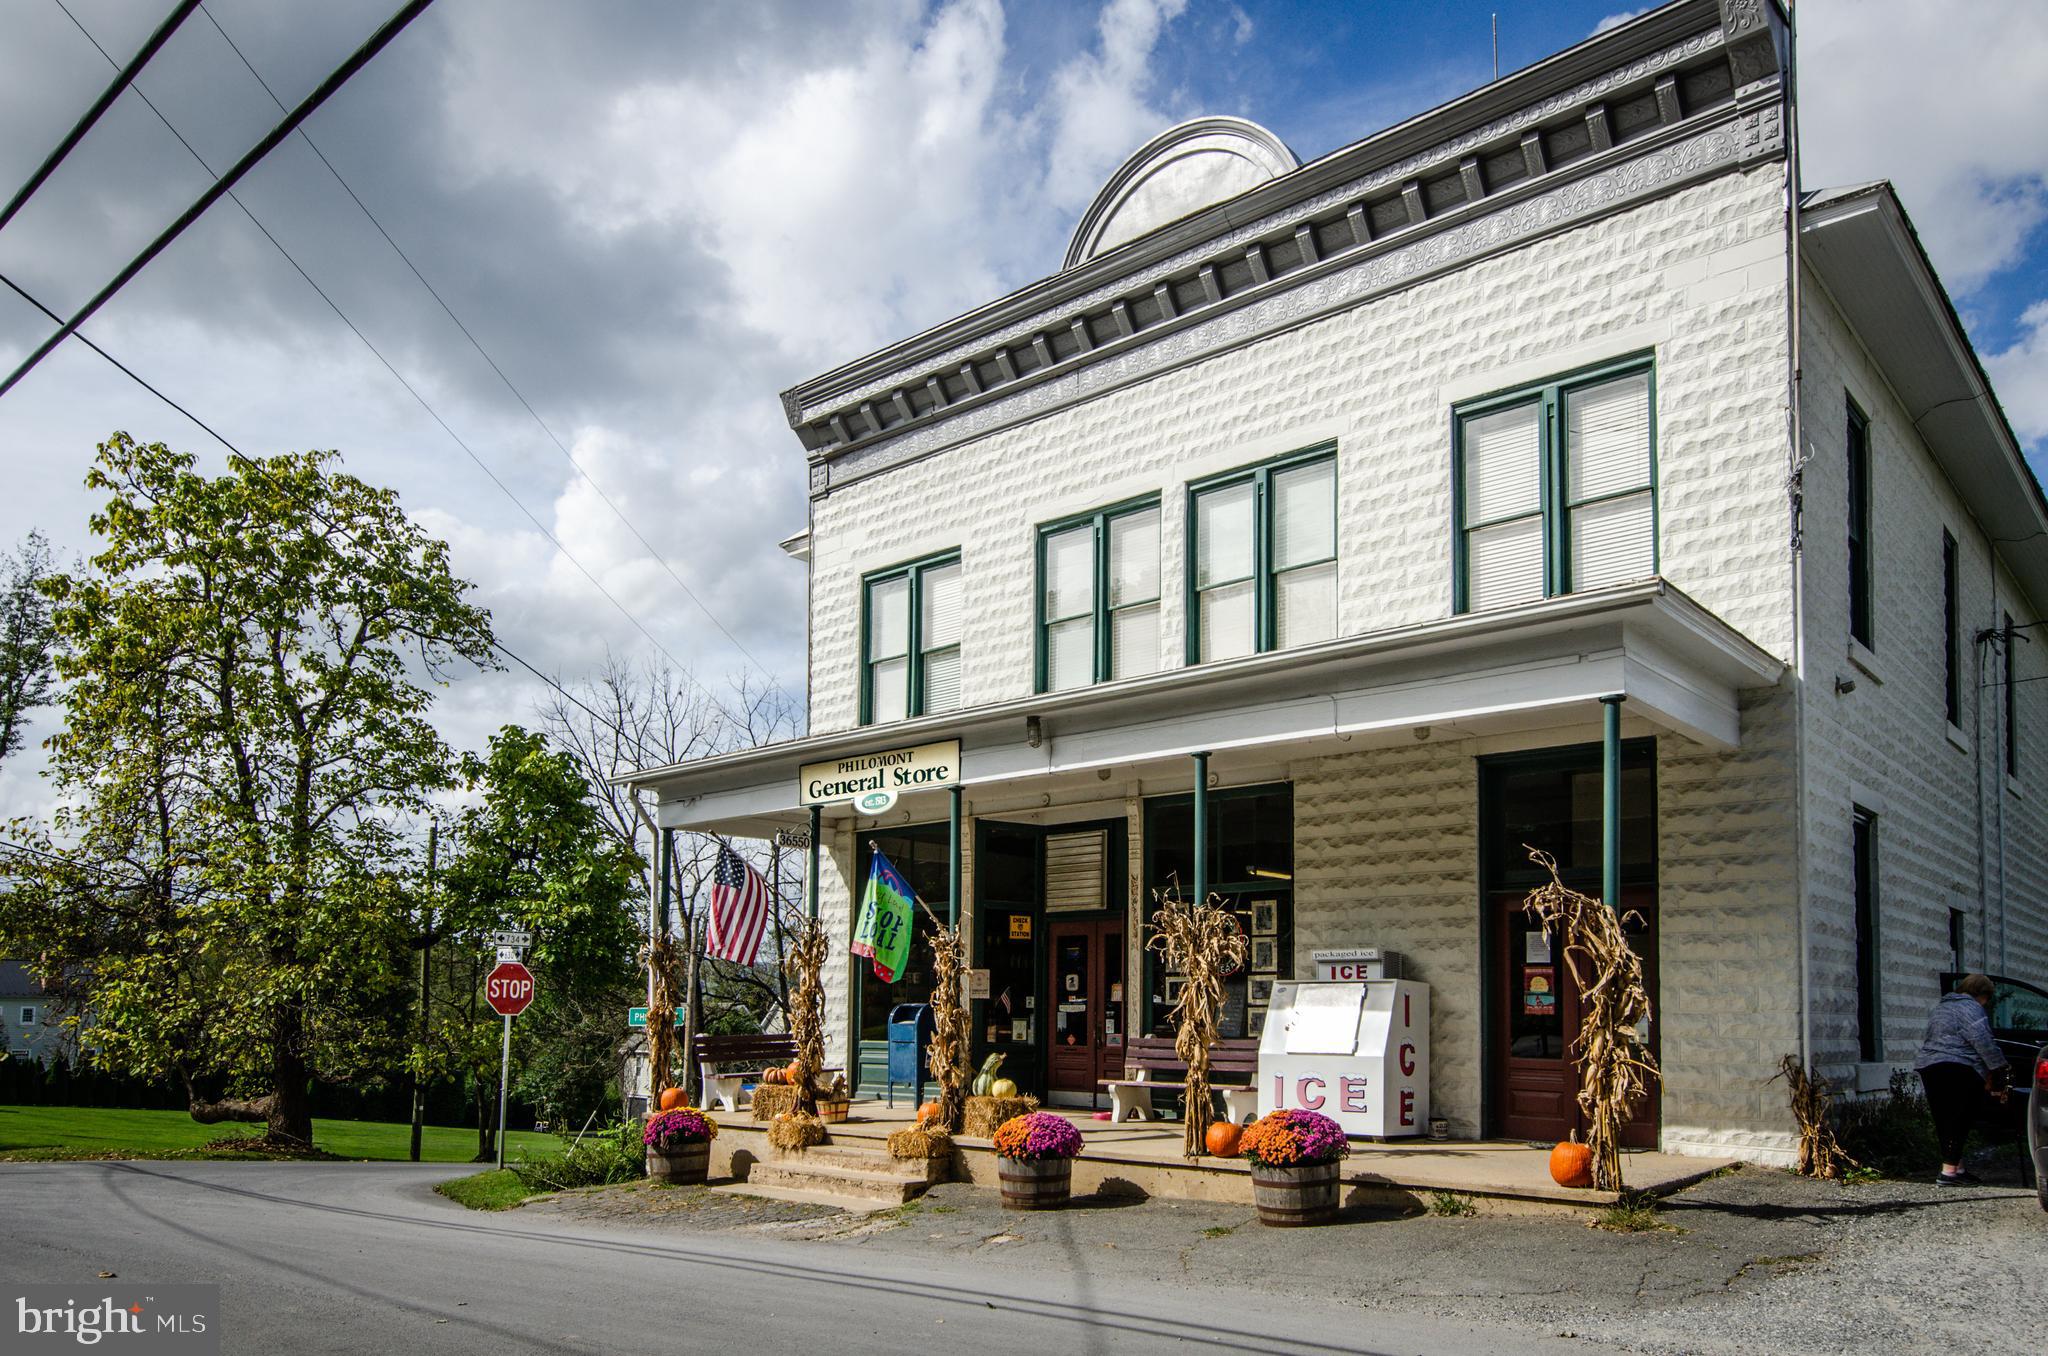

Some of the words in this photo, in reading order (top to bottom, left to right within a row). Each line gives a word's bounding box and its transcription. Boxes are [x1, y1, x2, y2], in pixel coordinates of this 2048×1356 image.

[838, 751, 914, 774] PHILOMONT
[809, 768, 885, 799] General
[893, 765, 949, 787] Store
[780, 834, 810, 848] 36550
[506, 934, 520, 943] 734
[1314, 950, 1357, 959] packaged
[1330, 964, 1368, 980] ICE
[489, 978, 531, 999] STOP
[1400, 990, 1416, 1127] ICE
[1274, 1071, 1368, 1113] ICE
